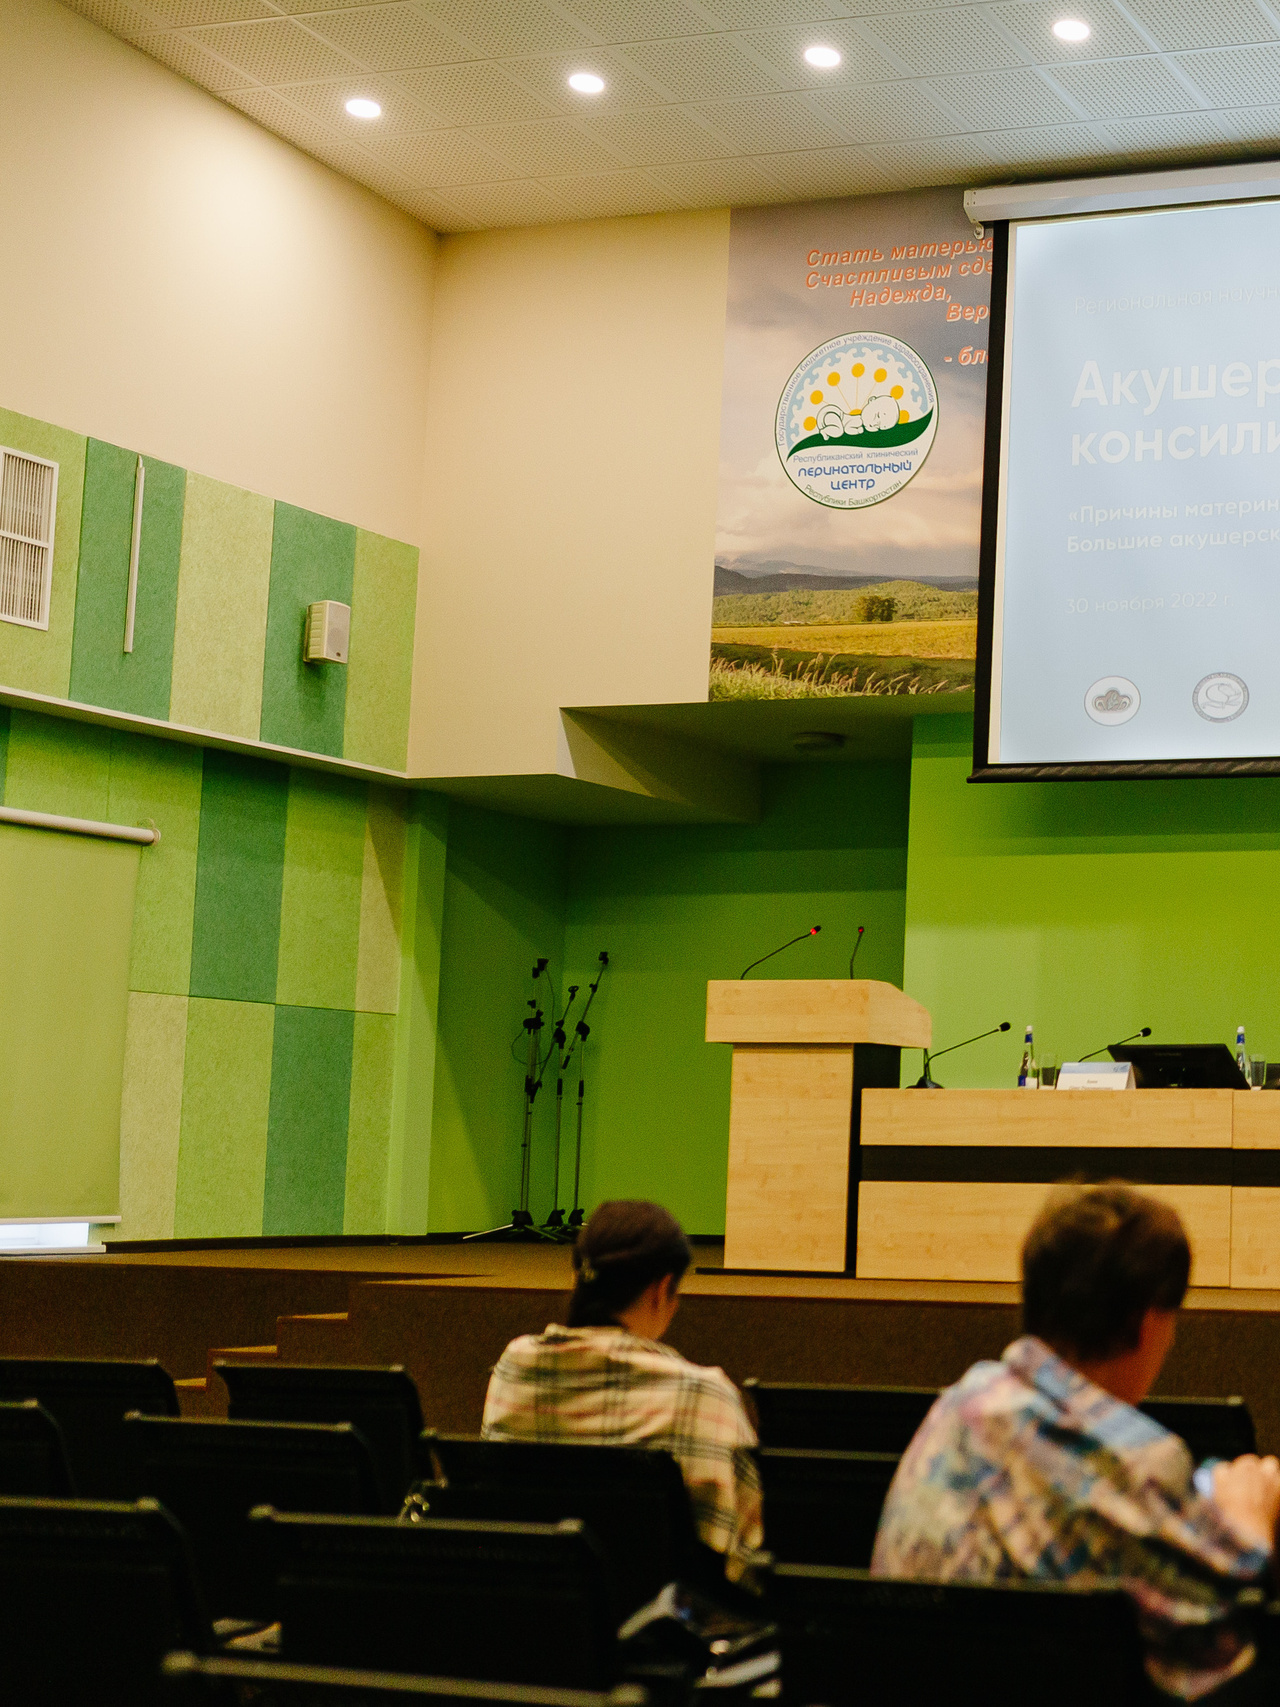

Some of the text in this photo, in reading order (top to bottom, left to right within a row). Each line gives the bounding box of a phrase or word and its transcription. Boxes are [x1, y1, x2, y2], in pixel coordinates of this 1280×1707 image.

[806, 248, 884, 268] Стать
[805, 262, 952, 289] Счастливым
[849, 282, 952, 308] Надежда,
[1073, 289, 1212, 315] Региональная
[946, 302, 991, 325] Вер
[793, 448, 919, 463] Республиканский клинический
[804, 480, 902, 506] Республики Башкортостан
[1068, 503, 1178, 526] «Причины
[1067, 532, 1162, 553] Большие
[1065, 598, 1089, 614] 30
[1095, 595, 1164, 614] ноября
[1171, 591, 1217, 609] 2022
